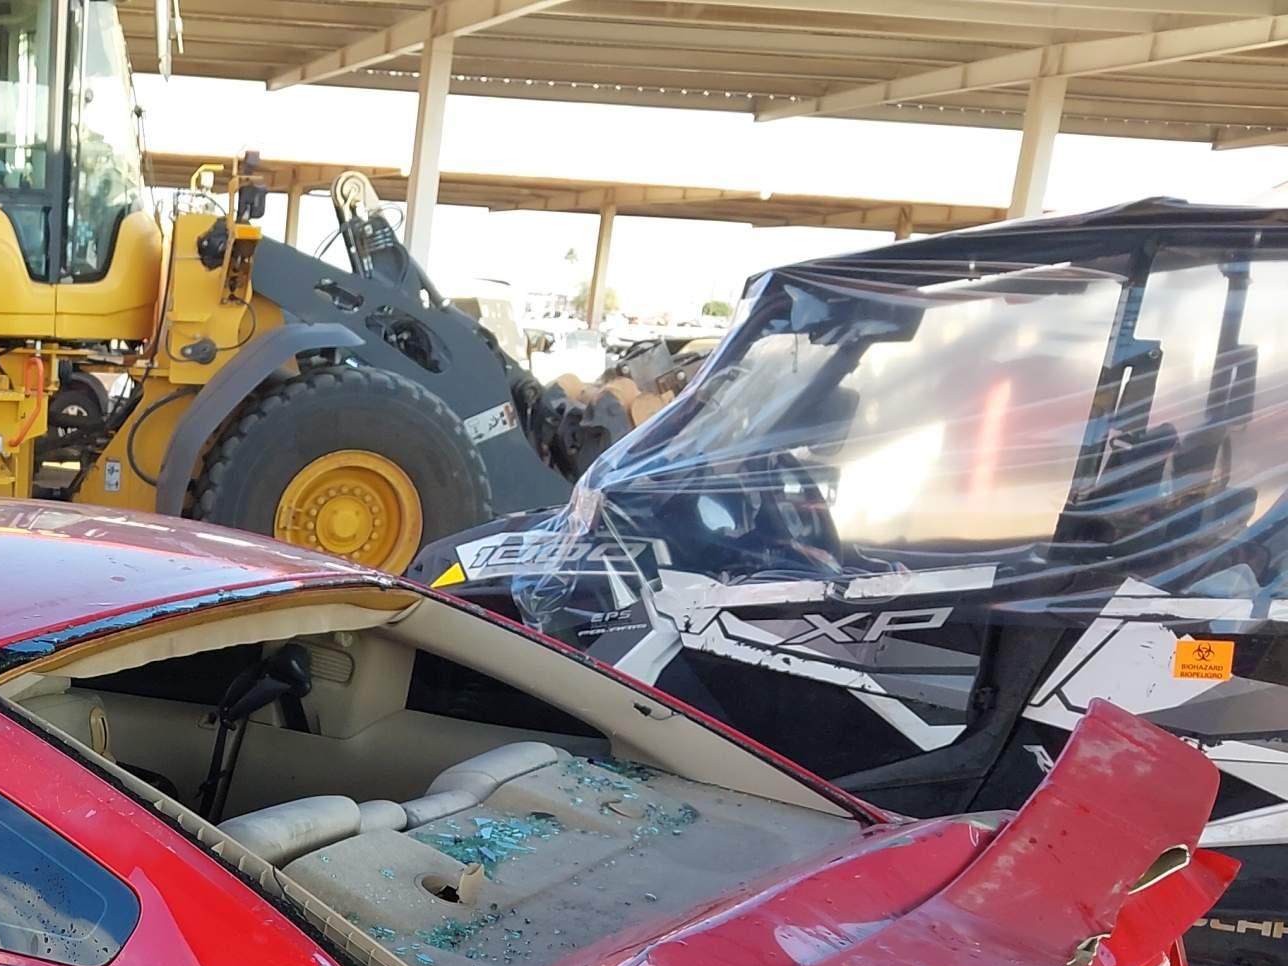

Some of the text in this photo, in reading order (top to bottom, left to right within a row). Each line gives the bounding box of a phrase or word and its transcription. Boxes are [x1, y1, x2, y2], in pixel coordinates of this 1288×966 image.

[590, 609, 633, 623] EPS
[783, 606, 954, 645] XP
[1181, 663, 1224, 672] BIOHAZARD
[1180, 671, 1223, 680] BIOPELIGRO
